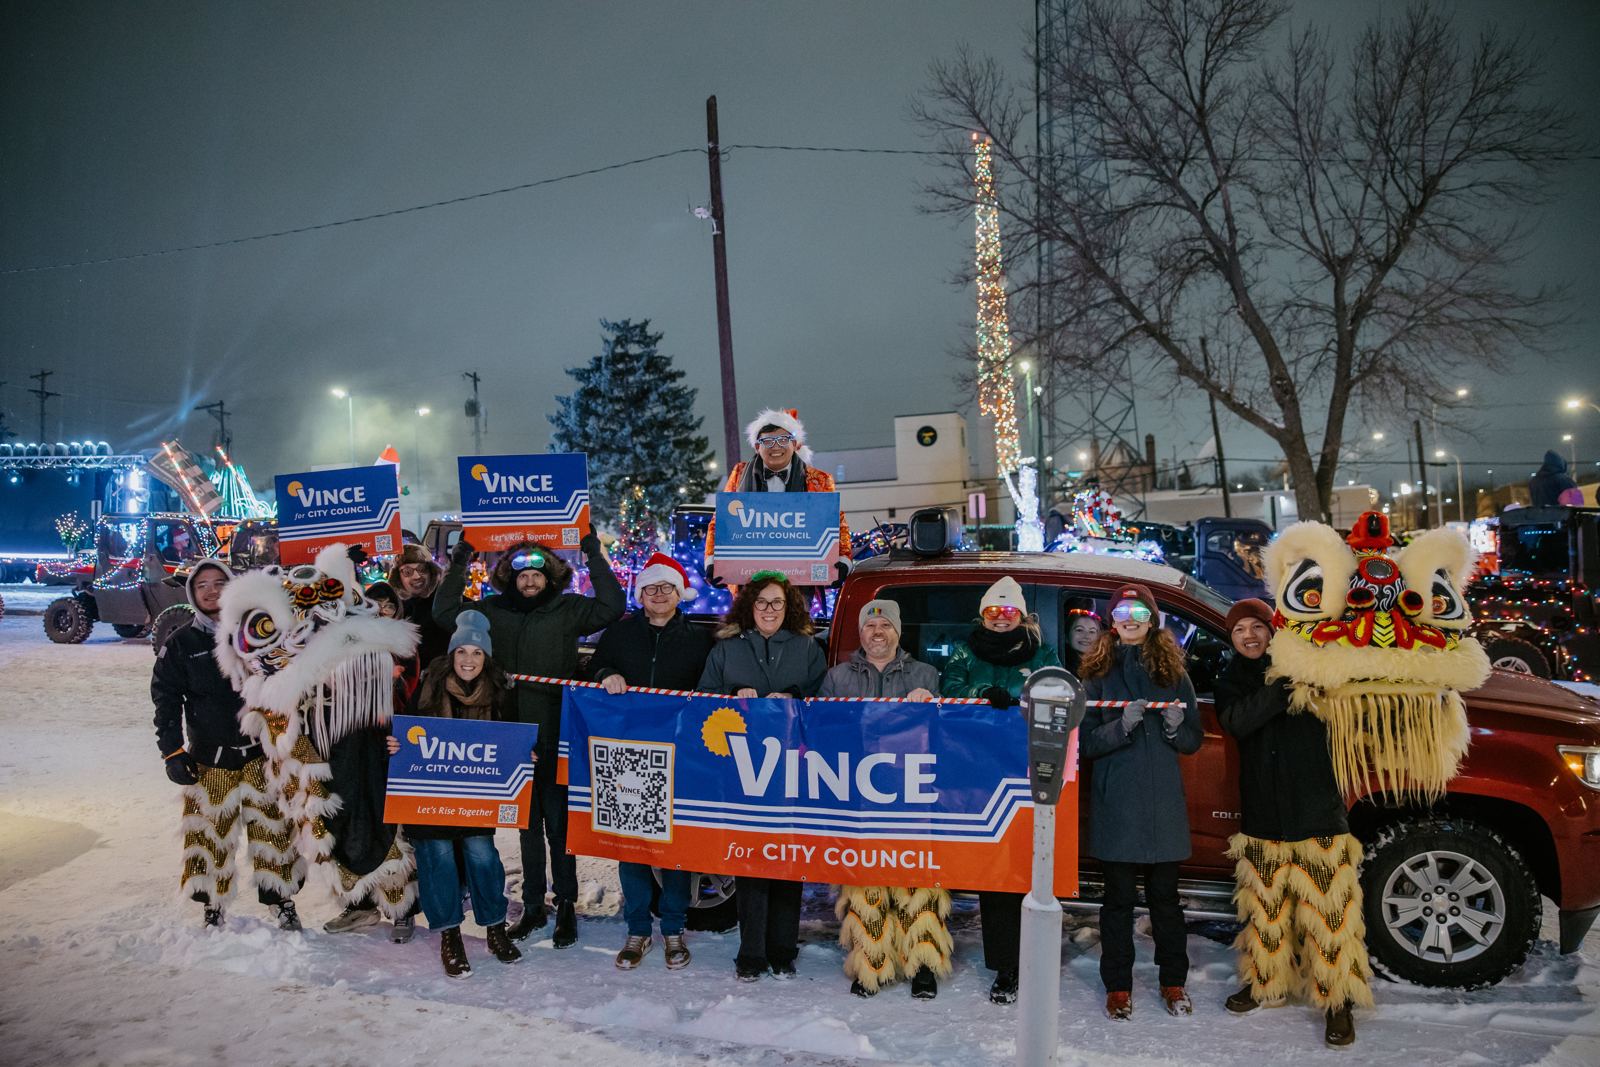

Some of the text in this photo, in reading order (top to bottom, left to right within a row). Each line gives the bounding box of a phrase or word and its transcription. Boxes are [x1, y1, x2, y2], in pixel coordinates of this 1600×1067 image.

[481, 472, 553, 493] VINCE
[297, 486, 366, 508] VINCE
[478, 495, 559, 506] for CITY COUNCIL
[294, 505, 372, 520] for CITY COUNCIL
[737, 508, 806, 528] VINCE
[526, 533, 558, 542] Together
[731, 532, 743, 540] for
[418, 736, 498, 762] VINCE
[409, 764, 502, 775] for CITY COUNCIL
[728, 735, 939, 804] VINCE
[619, 786, 641, 795] VINCE
[417, 805, 494, 817] Let's Rise Together
[724, 842, 941, 870] for CITY COUNCIL
